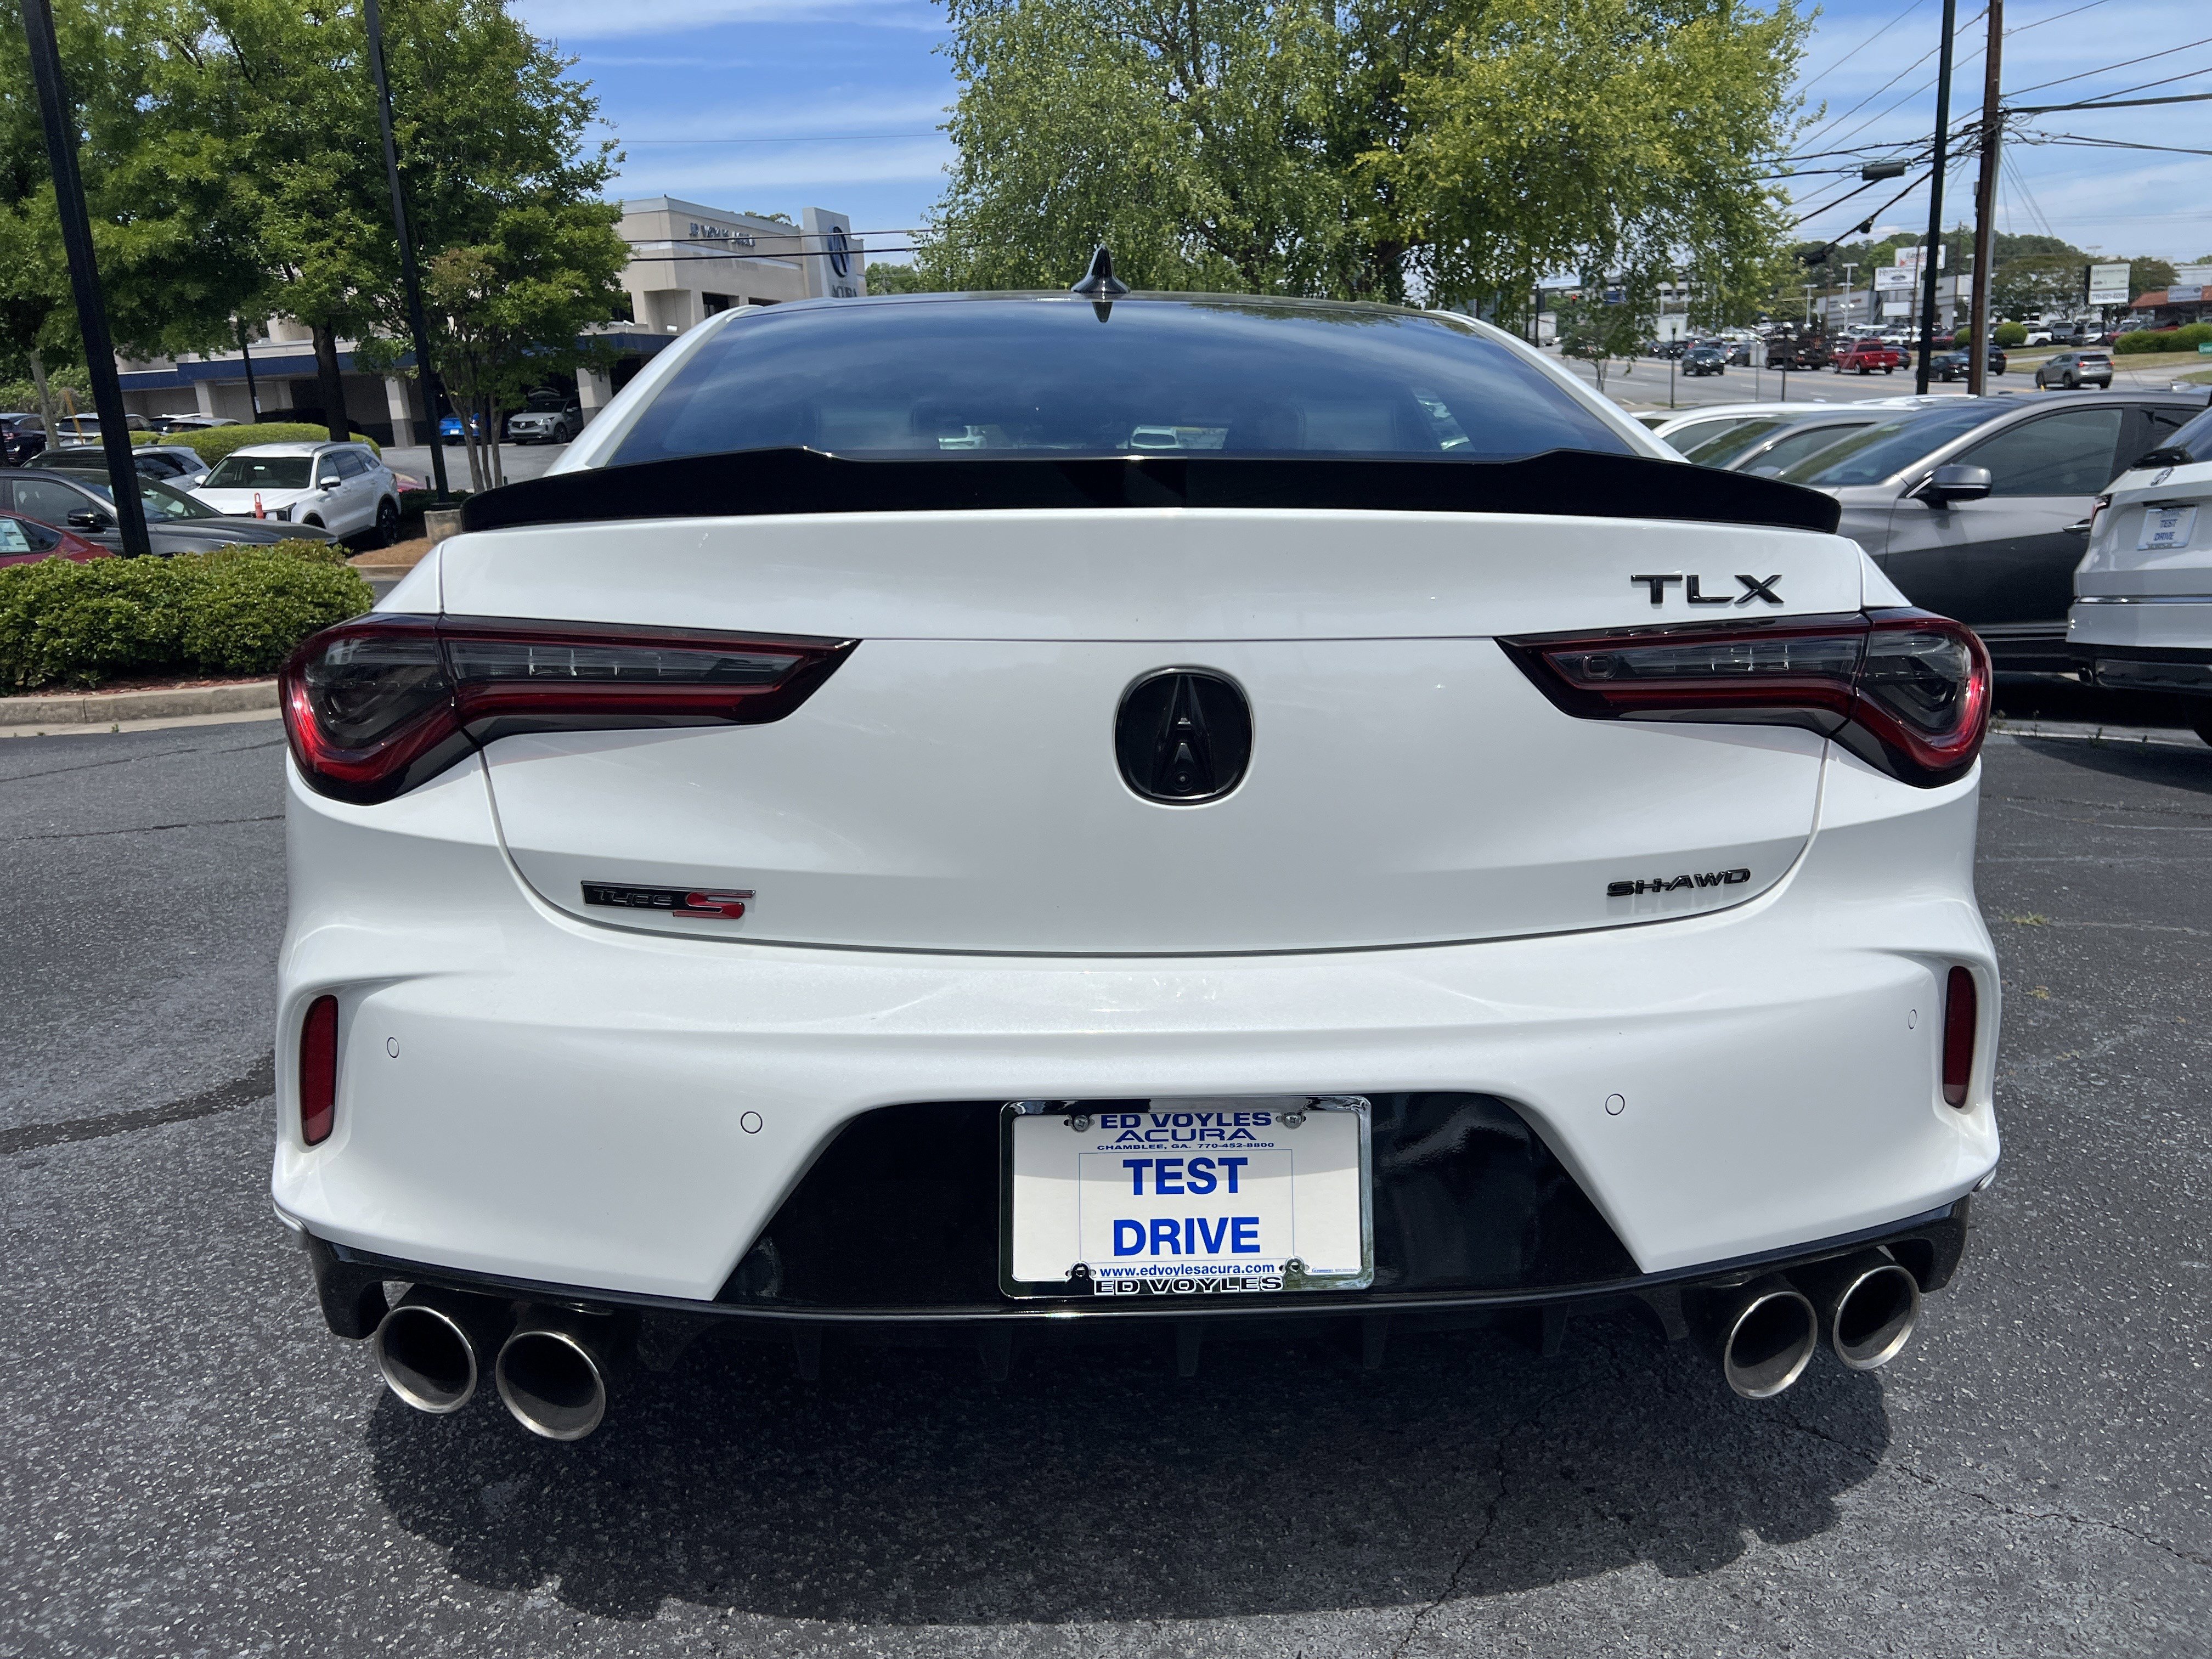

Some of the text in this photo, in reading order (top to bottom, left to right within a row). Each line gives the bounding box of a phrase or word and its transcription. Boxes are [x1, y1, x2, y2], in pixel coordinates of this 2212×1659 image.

[1630, 574, 1784, 604] TLX
[1101, 1112, 1272, 1129] ED VOYLES
[1114, 1128, 1257, 1143] ACURA
[1122, 1157, 1248, 1195] TEST
[1113, 1217, 1260, 1256] DRIVE
[1099, 1263, 1275, 1277] www.edvoylesacura.com
[1094, 1276, 1284, 1295] ED VOYLES
